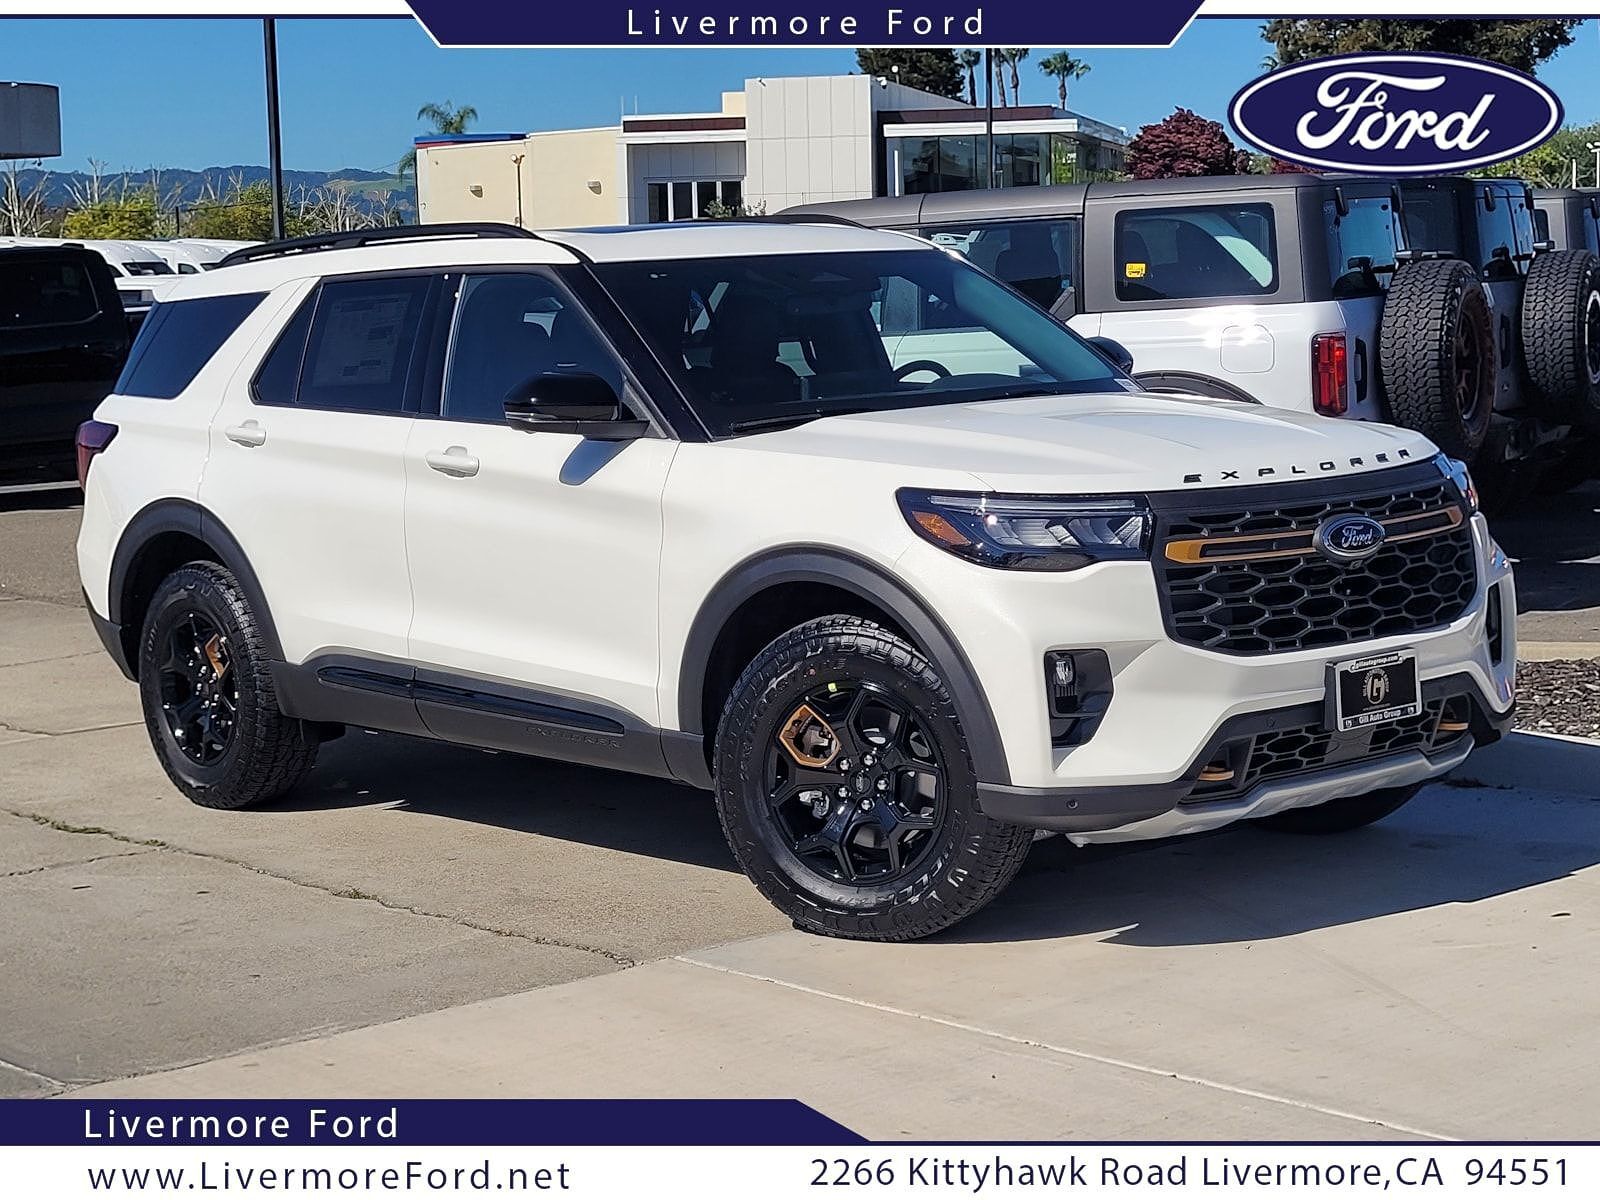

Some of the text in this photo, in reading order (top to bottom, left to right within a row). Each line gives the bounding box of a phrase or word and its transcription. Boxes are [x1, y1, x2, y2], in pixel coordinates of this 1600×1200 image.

[1183, 448, 1412, 484] EXPLORER
[1341, 525, 1373, 547] Ford
[1370, 712, 1383, 722] Auto
[1384, 709, 1401, 719] Group
